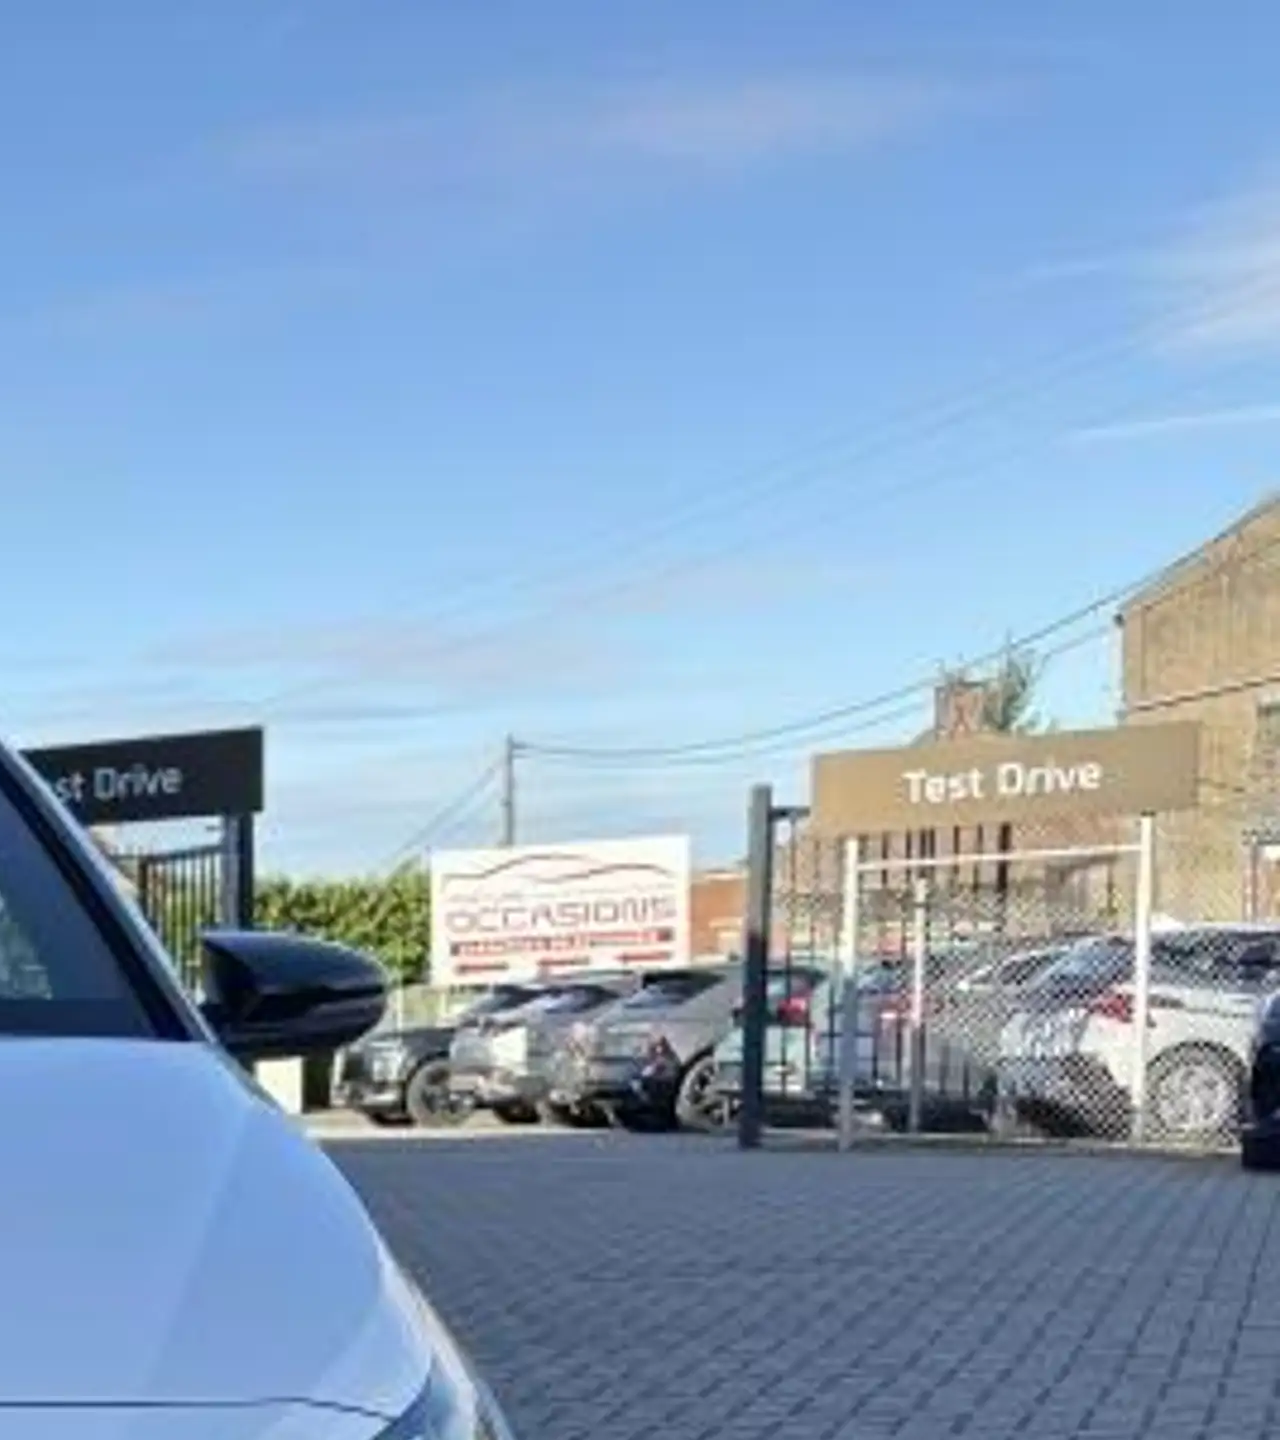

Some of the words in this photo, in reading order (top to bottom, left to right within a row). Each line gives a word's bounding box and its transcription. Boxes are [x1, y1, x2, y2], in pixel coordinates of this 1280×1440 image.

[94, 762, 183, 800] Drive
[901, 767, 985, 804] Test
[996, 756, 1103, 796] Drive
